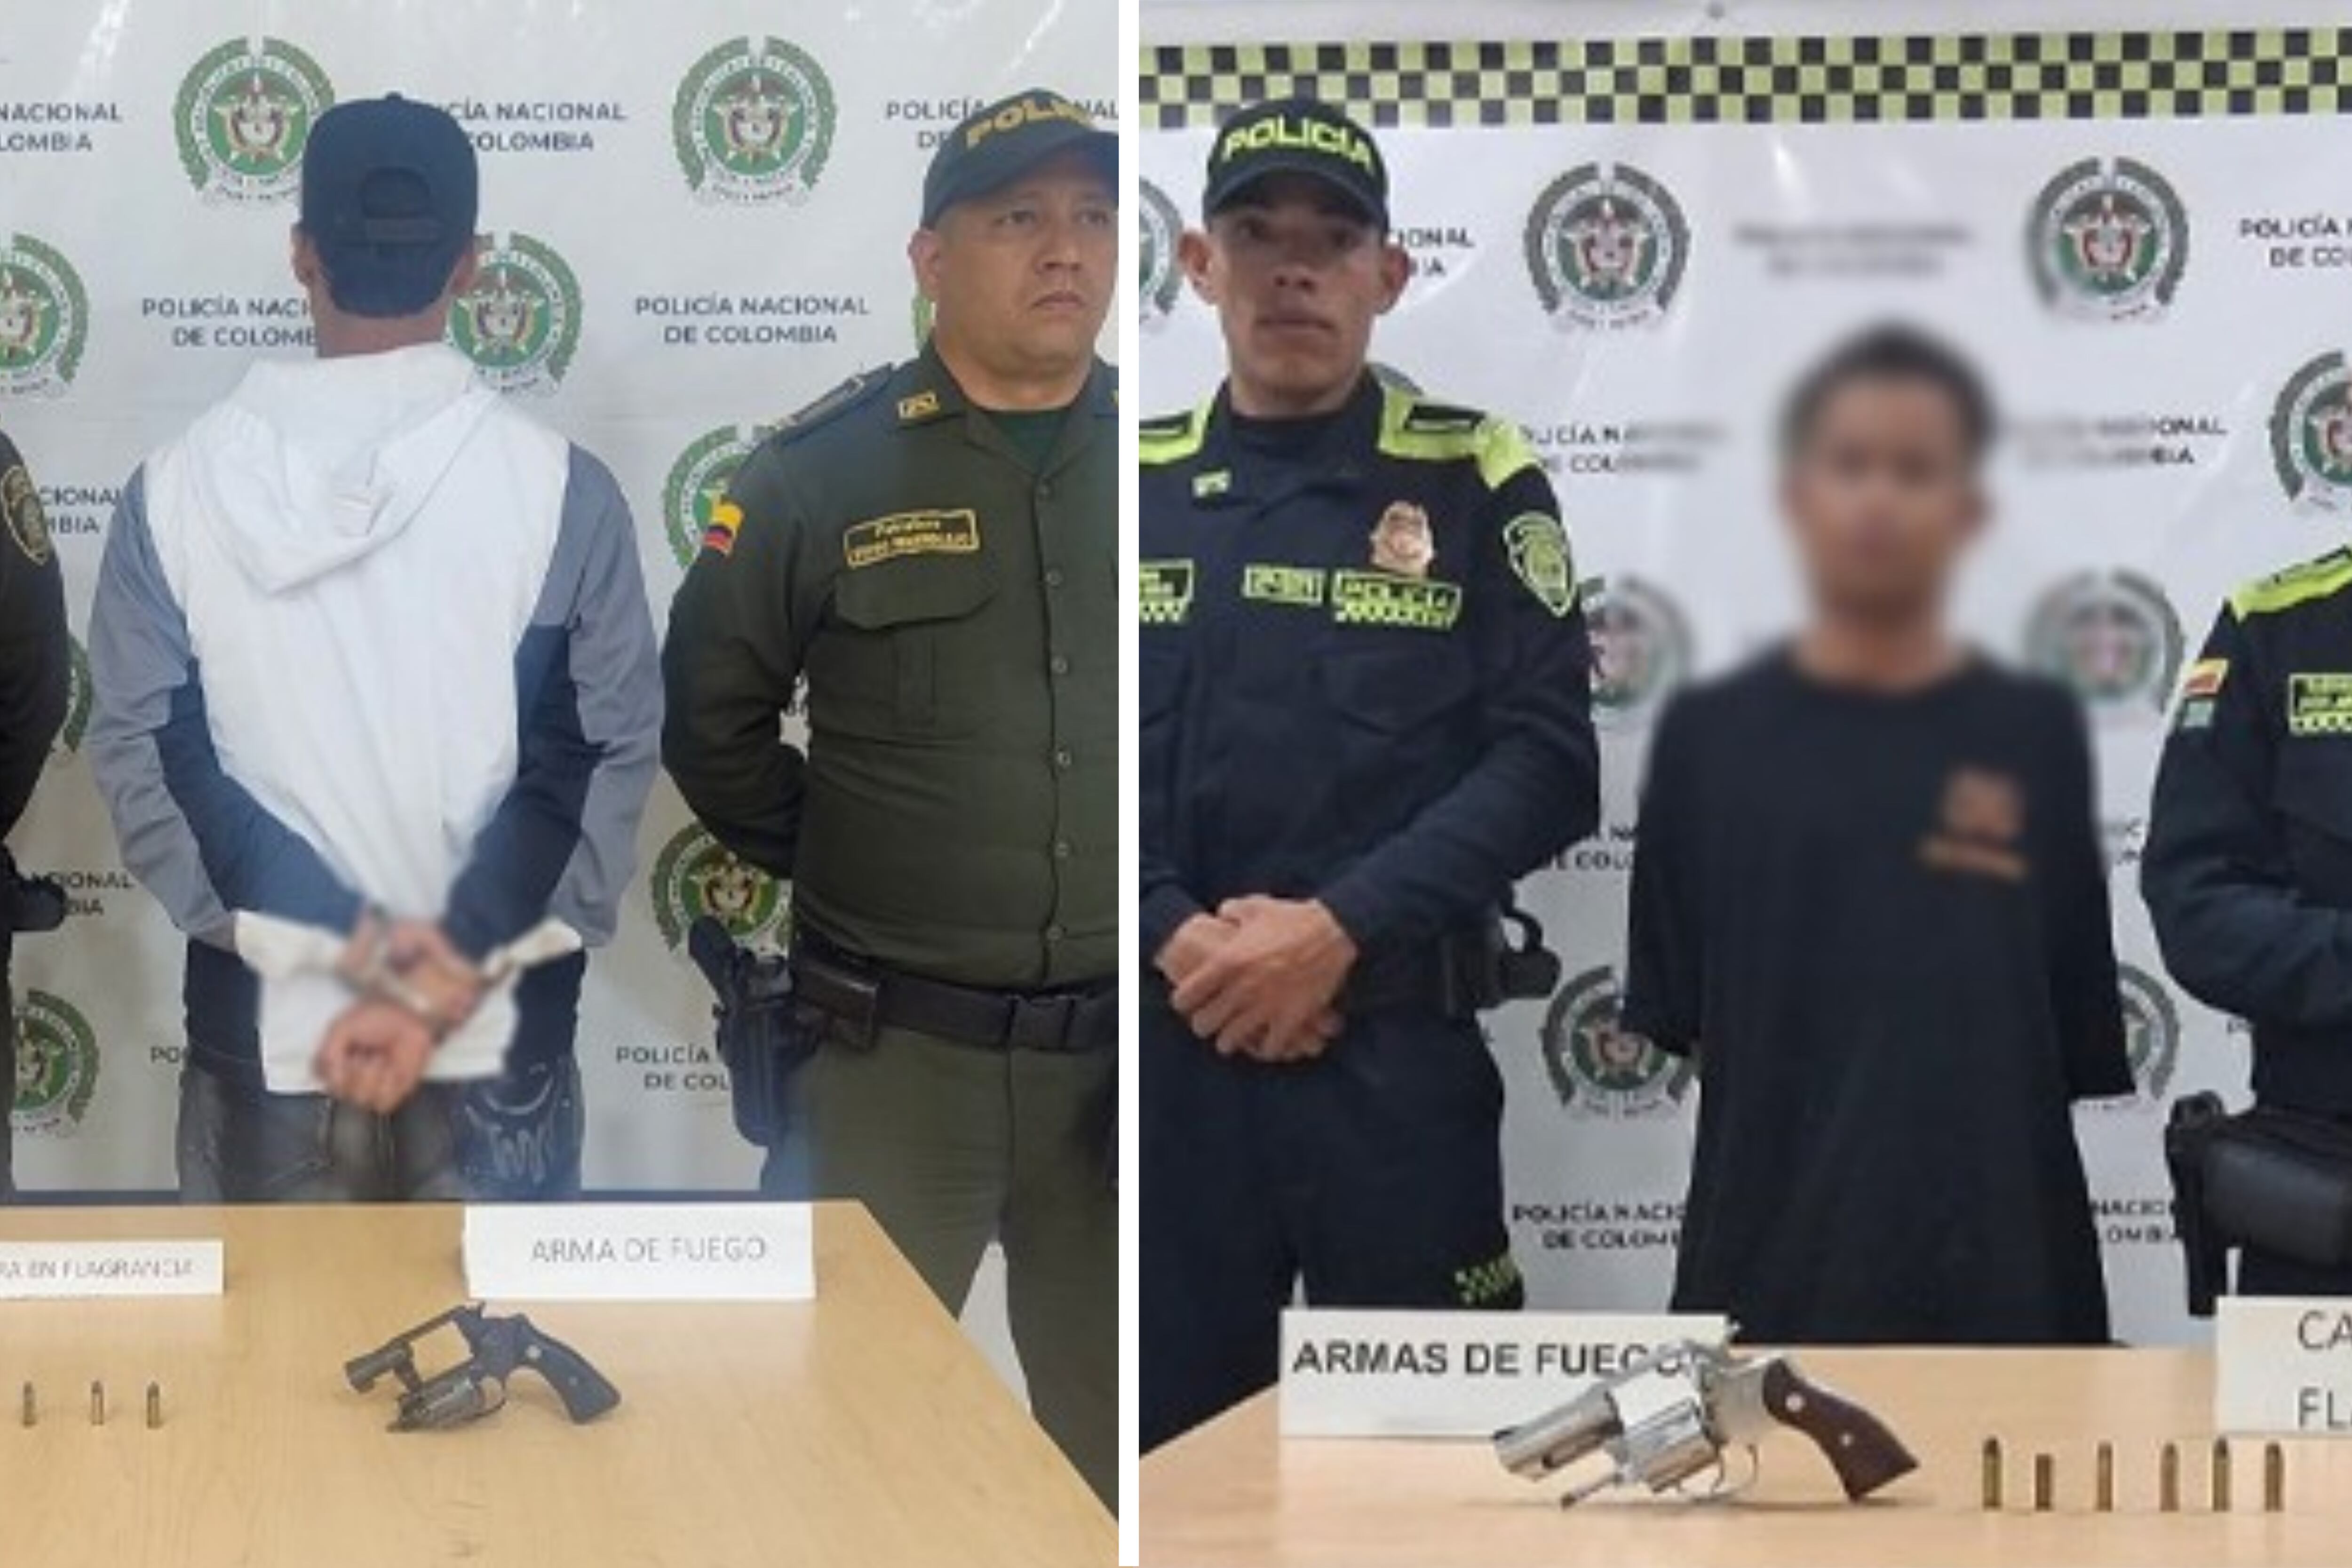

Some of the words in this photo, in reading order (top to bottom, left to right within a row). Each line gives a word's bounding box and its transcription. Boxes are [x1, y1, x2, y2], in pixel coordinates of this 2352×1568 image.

[497, 102, 628, 120] NACIONAL
[2240, 214, 2341, 238] POLICÍA
[2269, 246, 2305, 267] DE
[143, 294, 239, 318] POLICÍA
[247, 298, 311, 318] NACI
[636, 292, 733, 315] POLICÍA
[740, 297, 870, 315] NACIONAL
[174, 327, 207, 347] DE
[665, 326, 697, 344] DE
[706, 326, 837, 343] COLOMBIA
[616, 1043, 709, 1063] POLICÍA
[644, 1075, 676, 1090] DE
[1513, 1200, 1607, 1223] POLICÍA
[1543, 1229, 1574, 1249] DE
[531, 1238, 616, 1263] ARMA
[625, 1238, 660, 1262] DE
[673, 1237, 766, 1261] FUEGO
[30, 1260, 56, 1279] EN
[63, 1258, 193, 1279] FLAGRANCIA
[1293, 1343, 1448, 1375] ARMAS
[1465, 1344, 1519, 1375] DE
[2298, 1386, 2352, 1428] FL
